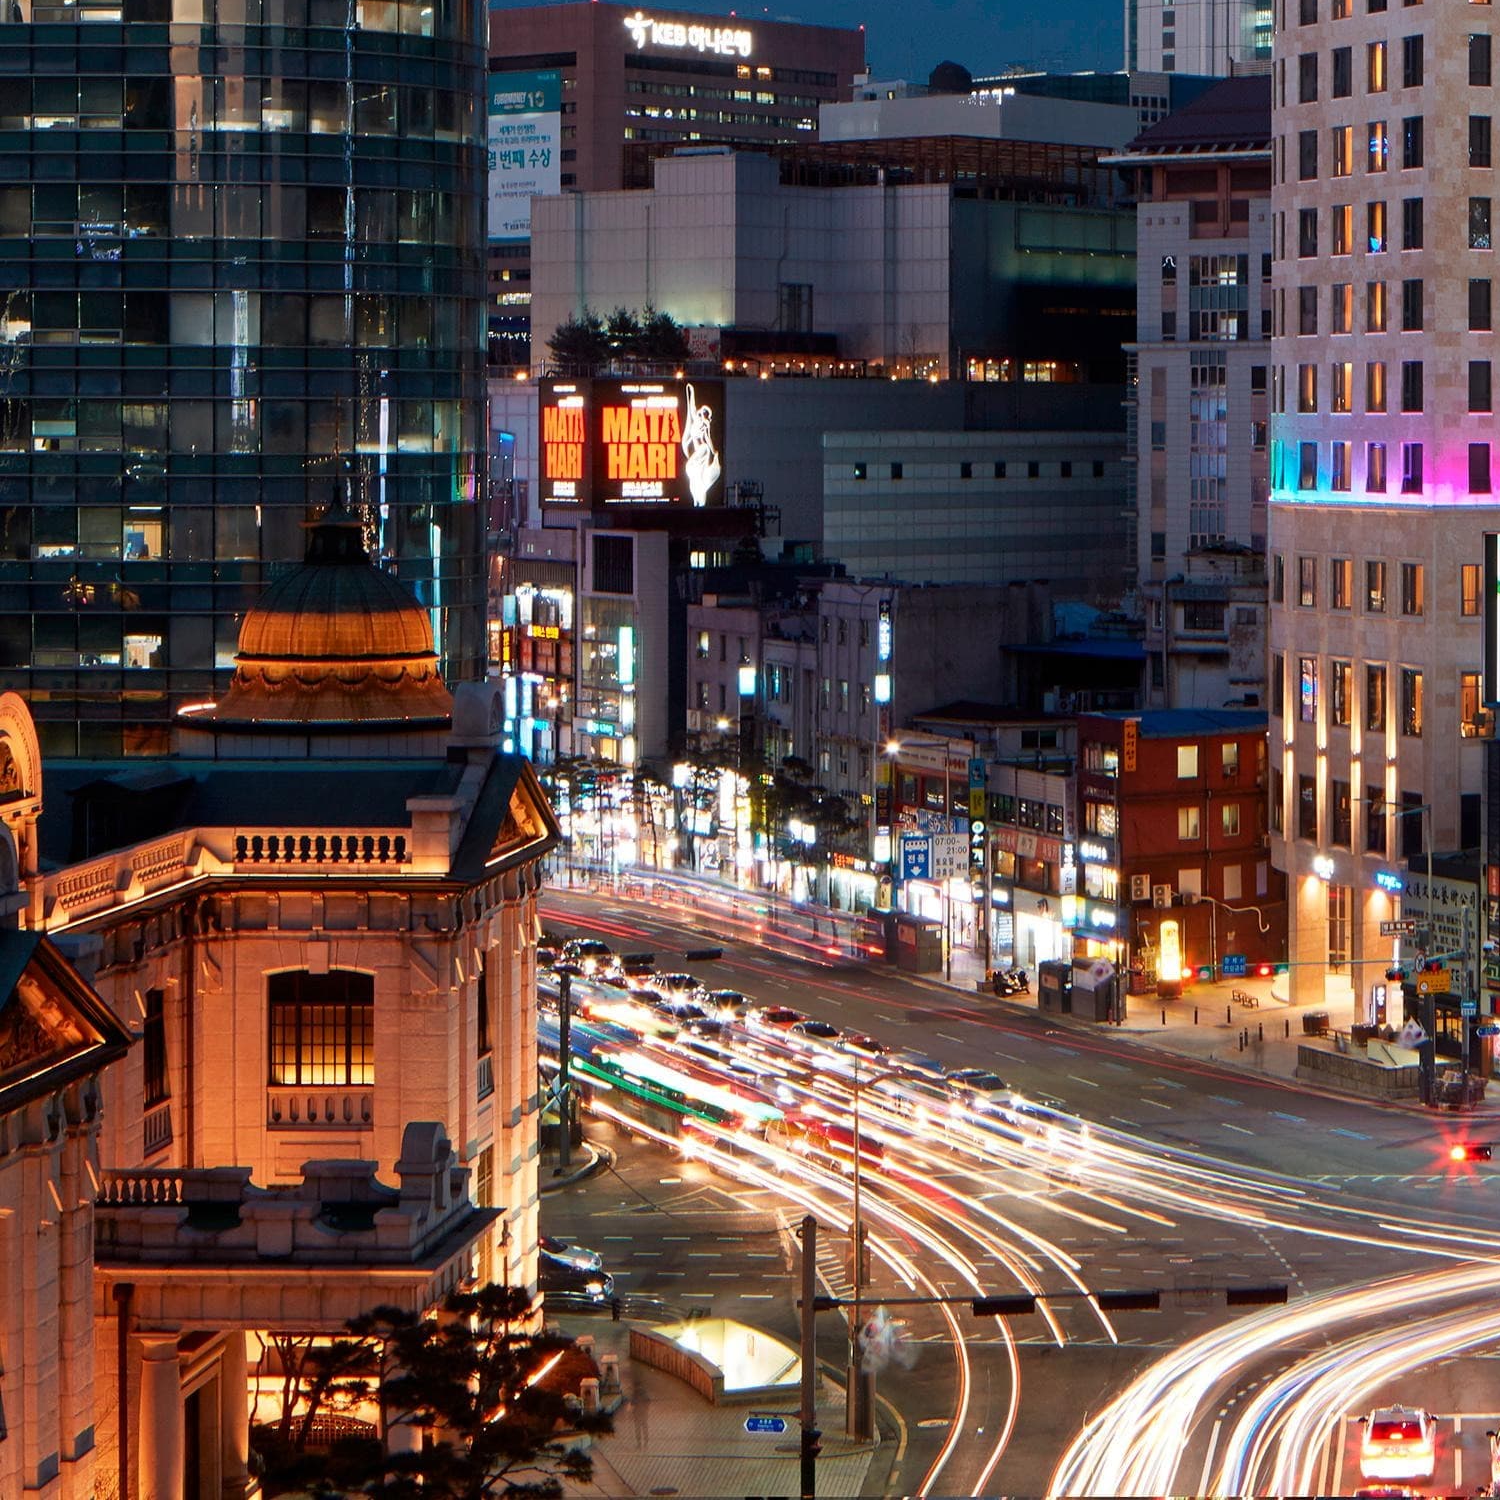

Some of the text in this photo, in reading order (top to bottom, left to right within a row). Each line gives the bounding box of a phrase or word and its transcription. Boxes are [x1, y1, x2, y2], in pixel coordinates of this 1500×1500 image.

[651, 22, 752, 57] KEB 하나은행
[500, 149, 525, 171] 번째
[528, 147, 552, 169] 수상
[544, 406, 585, 443] MATA
[602, 406, 682, 443] MATA
[546, 443, 583, 479] HARI
[608, 443, 677, 479] HARI
[907, 853, 925, 864] 전용
